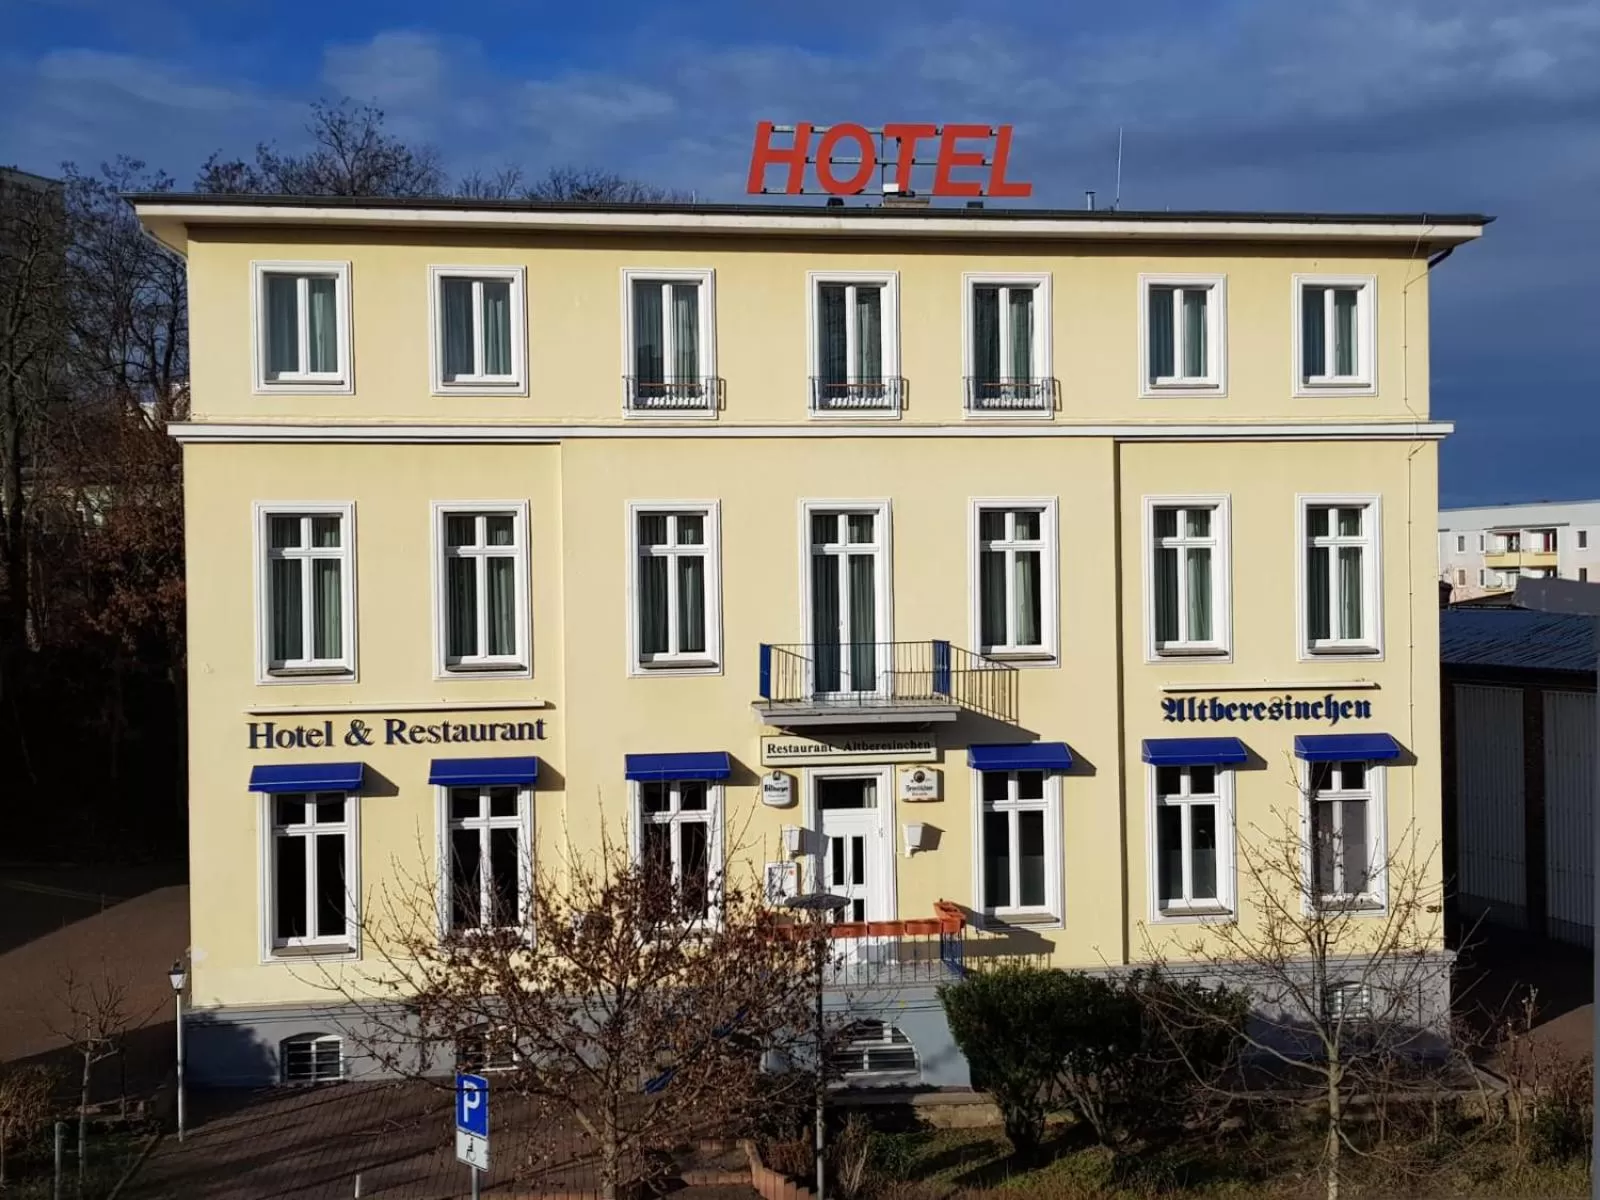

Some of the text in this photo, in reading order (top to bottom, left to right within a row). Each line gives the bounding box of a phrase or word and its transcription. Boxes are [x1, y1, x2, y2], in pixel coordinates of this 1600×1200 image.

[747, 121, 1032, 197] HOTEL
[1161, 694, 1373, 726] Altberesinchen
[247, 717, 547, 749] Hotel & Restaurant
[767, 742, 833, 754] Restaurant
[843, 739, 931, 752] Altberesinchen
[463, 1080, 481, 1123] P
